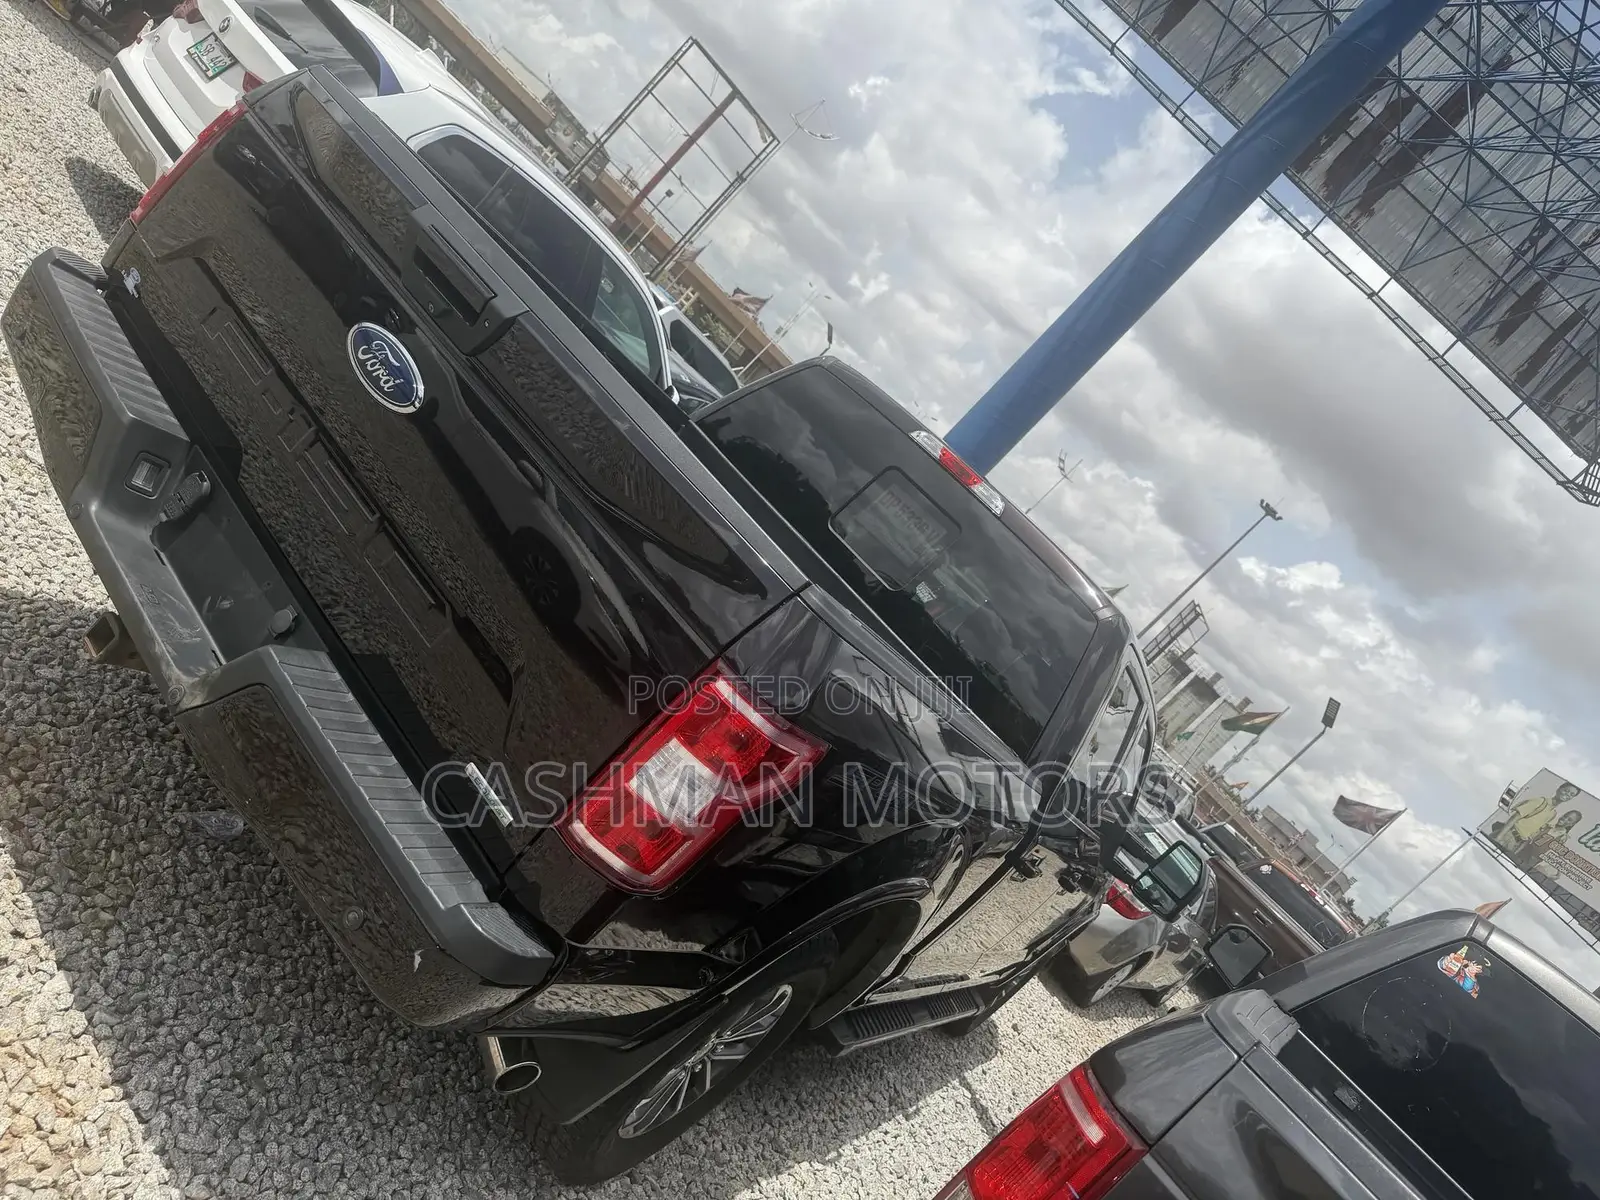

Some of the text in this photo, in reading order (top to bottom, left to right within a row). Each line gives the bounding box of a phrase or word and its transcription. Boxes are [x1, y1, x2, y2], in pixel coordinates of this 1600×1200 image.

[357, 340, 404, 392] Ford
[1539, 853, 1593, 890] EDUCATION PROJECT
